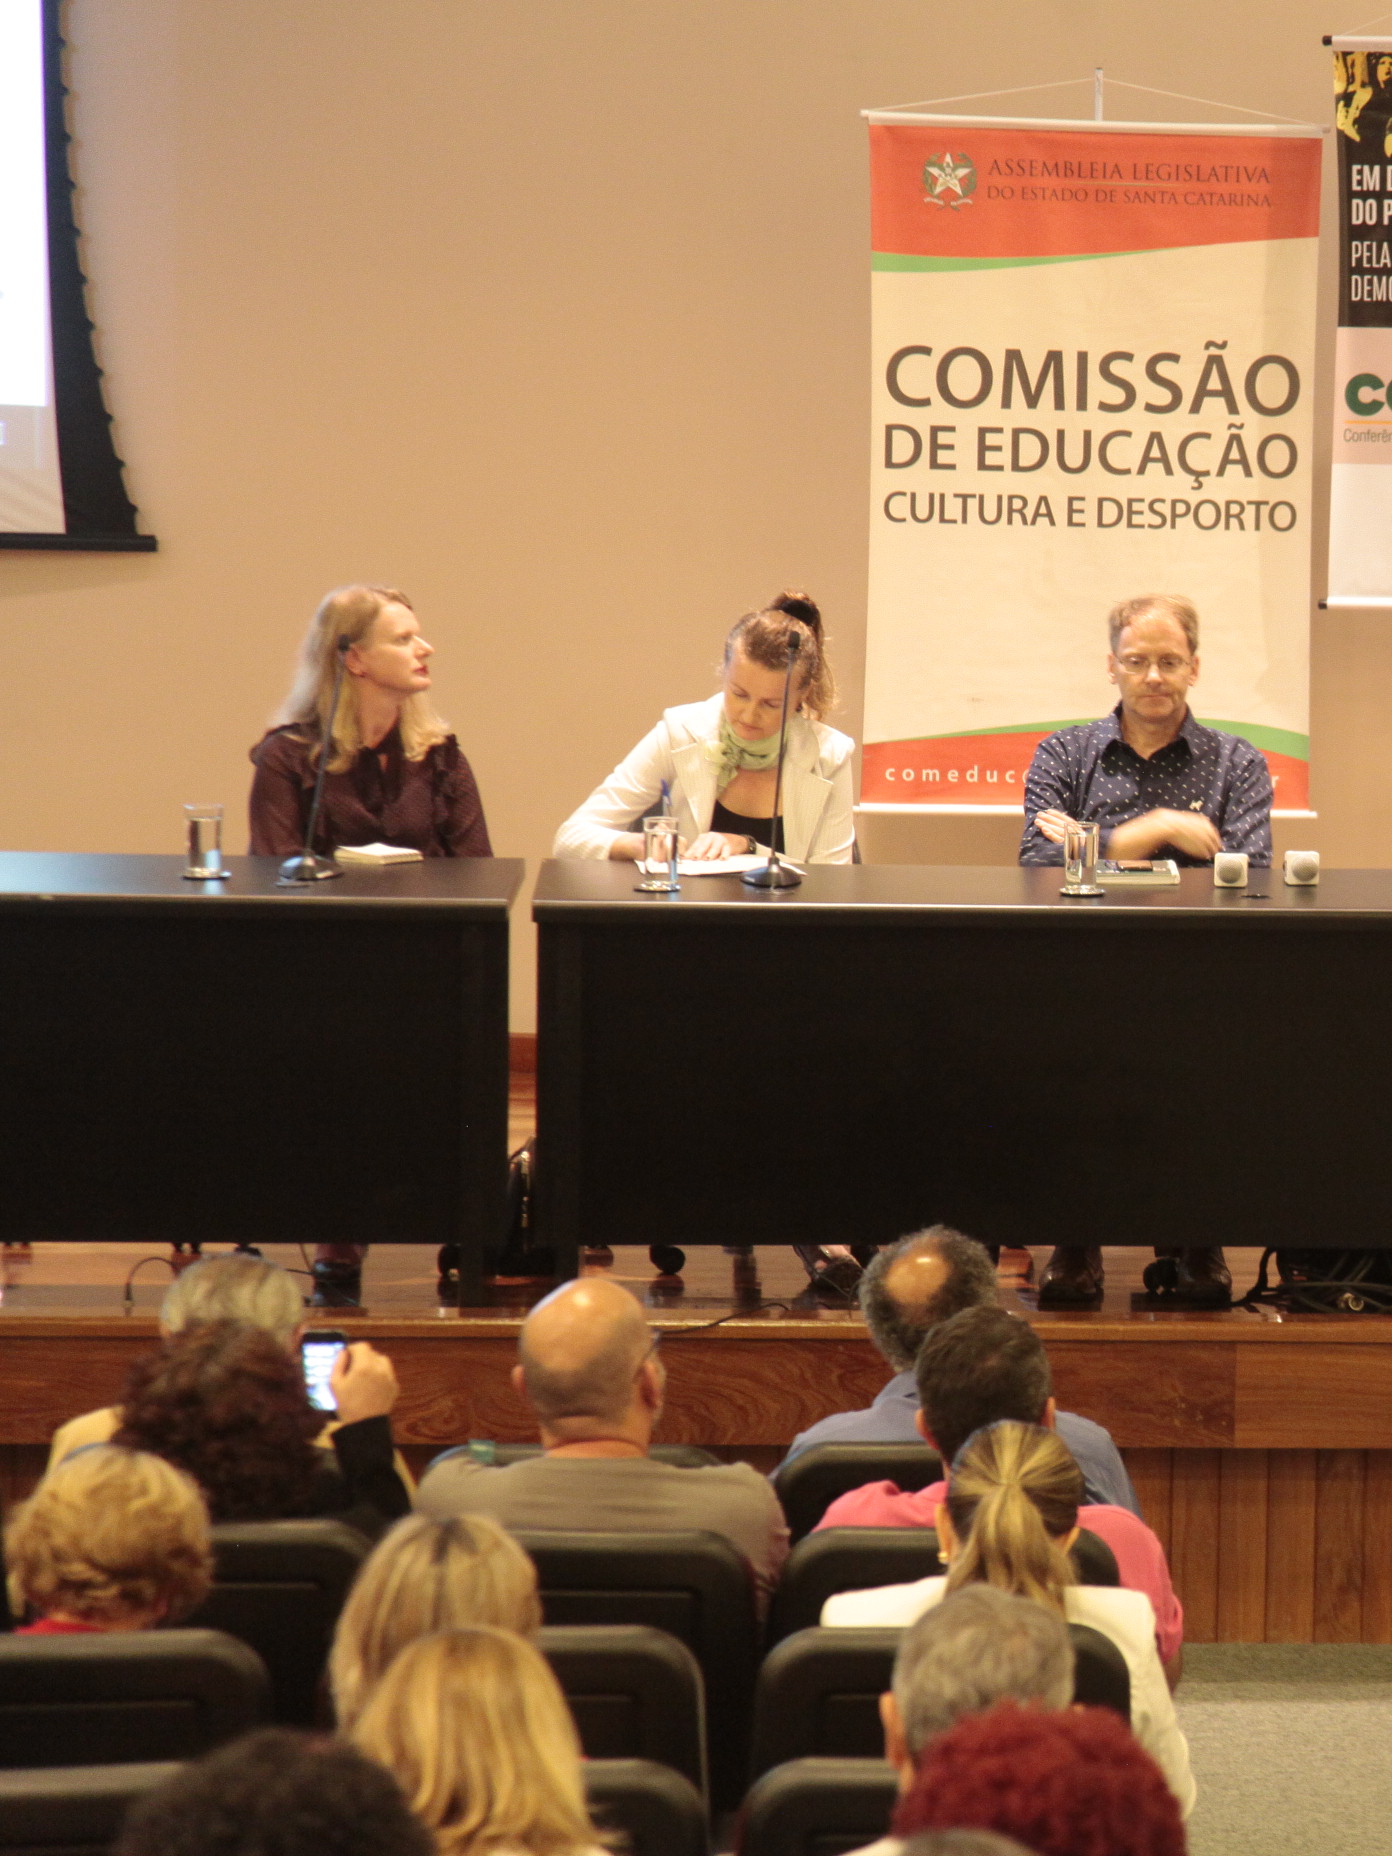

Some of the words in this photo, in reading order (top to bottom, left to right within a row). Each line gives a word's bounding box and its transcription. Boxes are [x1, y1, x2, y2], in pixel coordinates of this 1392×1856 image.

[988, 159, 1123, 180] ASSEMBLEIA
[1132, 163, 1271, 185] LEGISLATIVA
[1351, 165, 1380, 192] EM
[987, 186, 1015, 200] DO
[1021, 187, 1088, 202] ESTADO
[1095, 189, 1117, 203] DE
[1123, 190, 1178, 205] SANTA
[1184, 191, 1272, 208] CATARINA
[1351, 199, 1377, 226] DO
[1351, 241, 1391, 269] PELA
[885, 340, 1301, 417] COMISSÃO
[884, 424, 957, 471] DE
[976, 422, 1298, 490] EDUCAÇÃO
[883, 491, 1056, 528] CULTURA
[1067, 496, 1086, 528] E
[1096, 498, 1297, 533] DESPORTO
